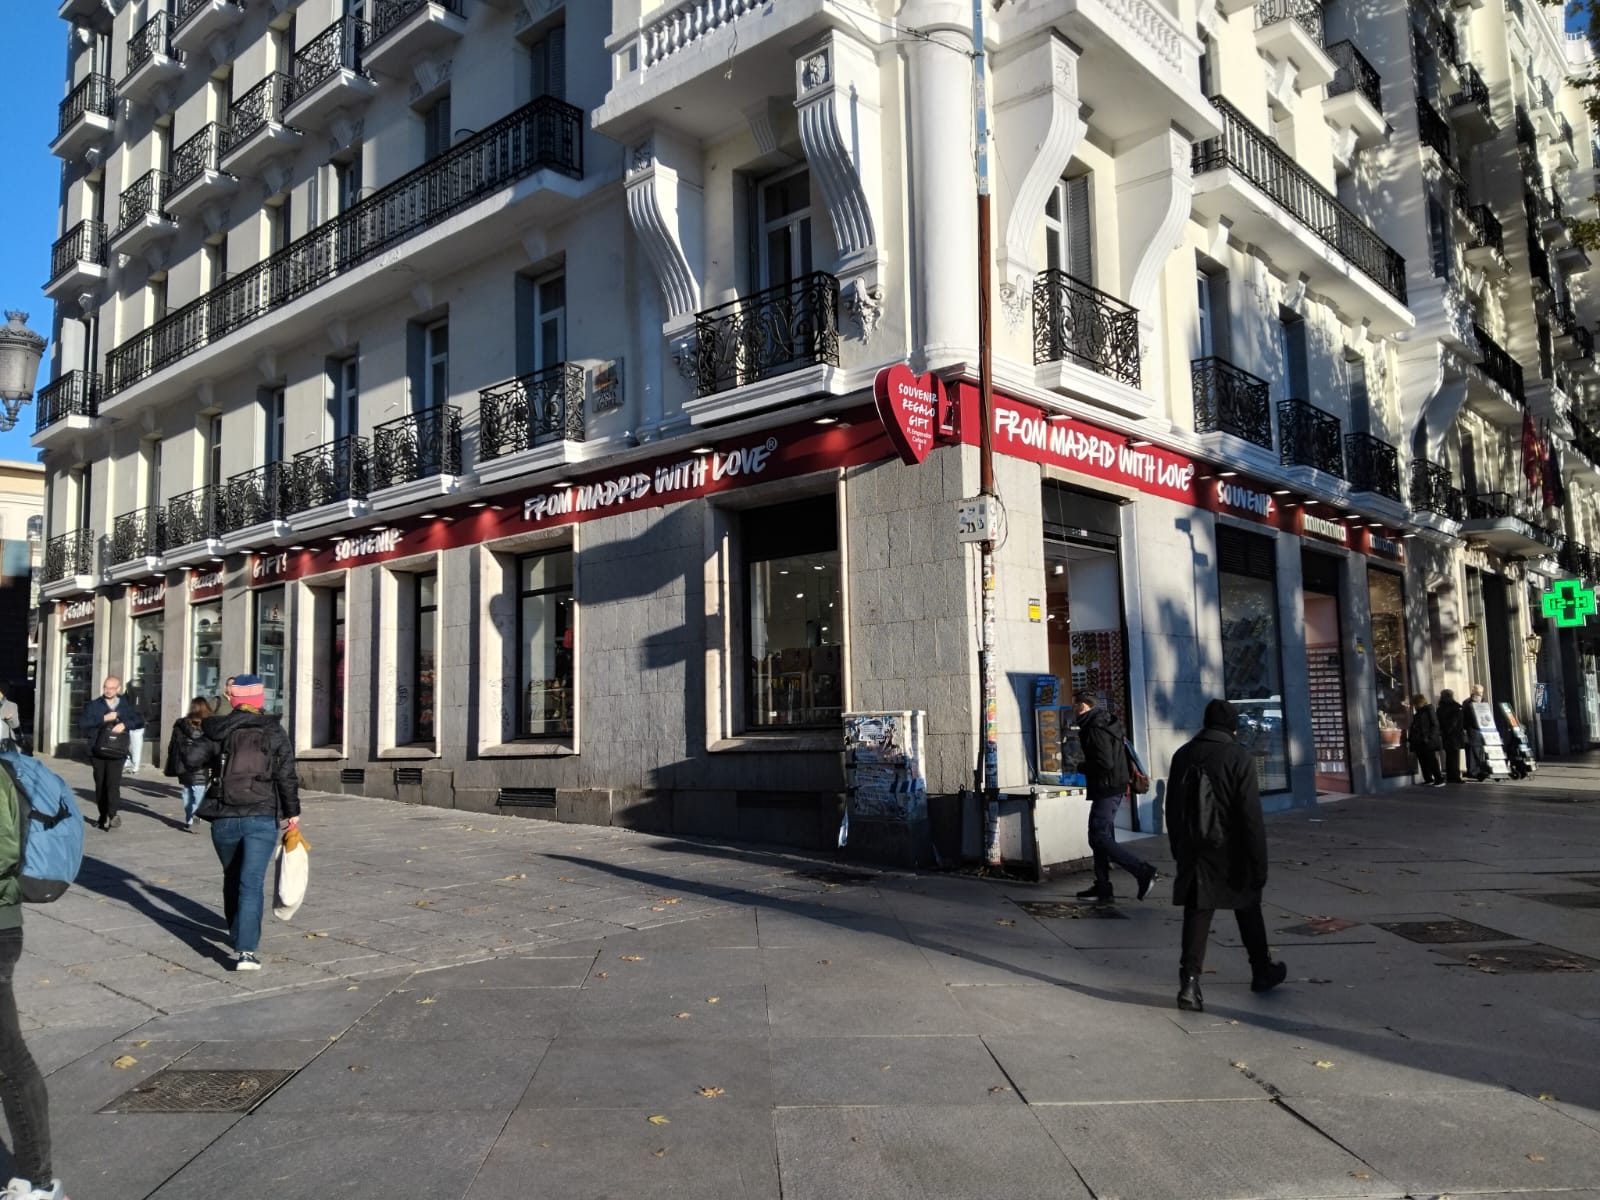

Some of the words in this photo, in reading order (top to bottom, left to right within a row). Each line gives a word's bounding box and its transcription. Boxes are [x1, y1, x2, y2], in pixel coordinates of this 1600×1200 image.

[898, 383, 938, 403] SOUVENIR
[902, 398, 936, 417] REGALO
[908, 415, 929, 430] GIFT
[995, 407, 1046, 450] FROM
[1049, 425, 1116, 468] MADRID
[1118, 443, 1156, 483] WITH
[524, 487, 573, 520] FROM
[575, 472, 651, 512] MADRID
[654, 455, 709, 493] WITH
[1217, 480, 1275, 517] SOUVENIR
[1303, 513, 1347, 541] miramira
[335, 528, 404, 561] SOUVENIR
[131, 583, 166, 606] FUTBOL
